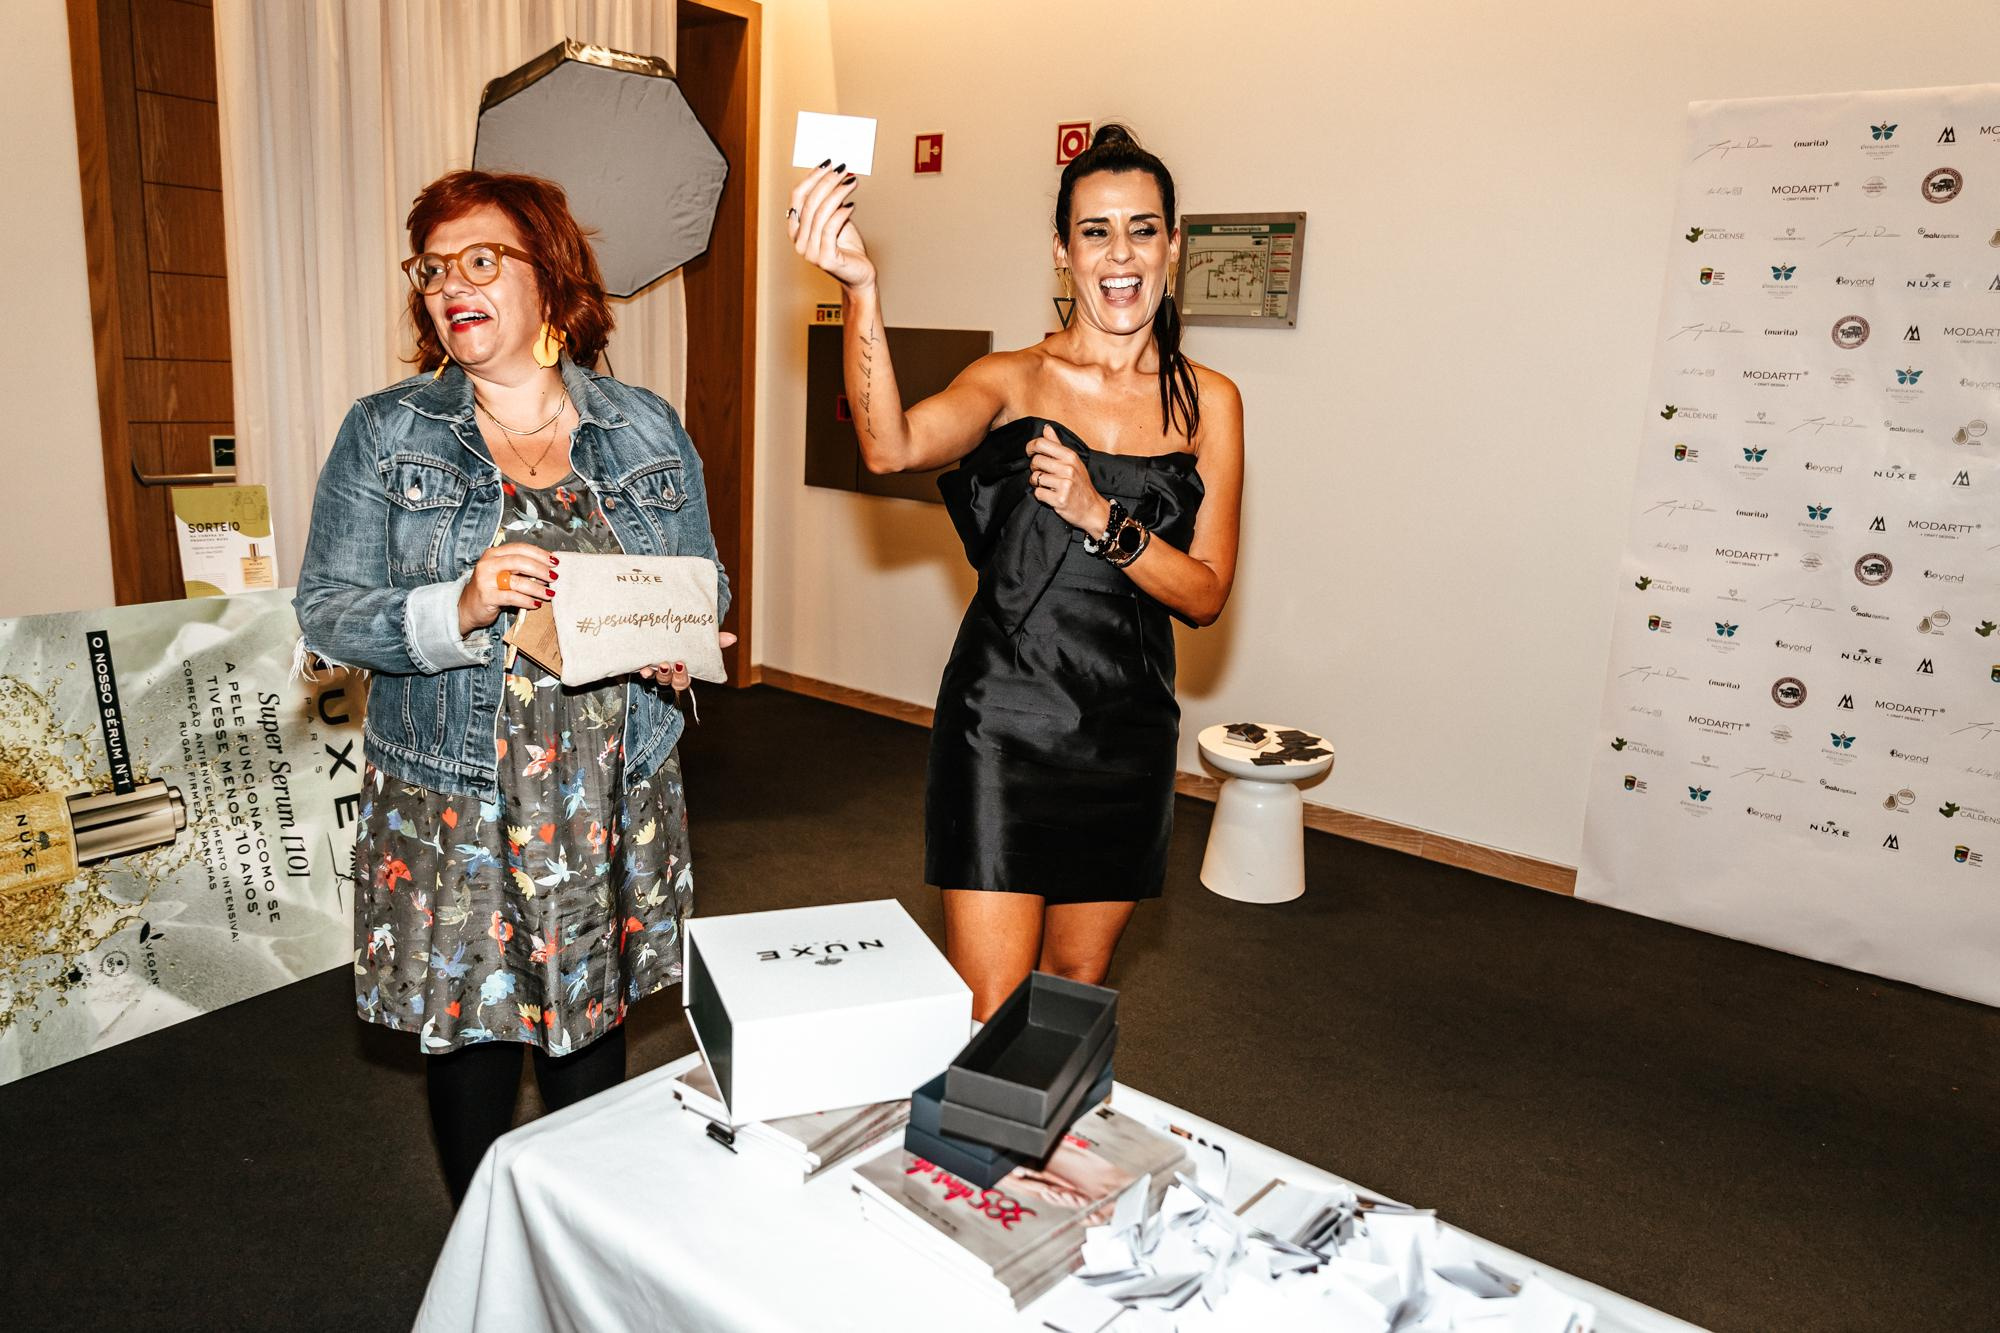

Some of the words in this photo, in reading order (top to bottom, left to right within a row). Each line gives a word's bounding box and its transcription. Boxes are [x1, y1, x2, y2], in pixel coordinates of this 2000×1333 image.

[1793, 139, 1829, 148] (marita)
[1836, 276, 1875, 287] Beyond
[1906, 280, 1952, 289] NUXE
[1765, 328, 1798, 337] (marita)
[1804, 462, 1843, 474] Beyond
[1873, 470, 1918, 481] NUXE
[1736, 509, 1769, 519] (marita)
[188, 522, 240, 534] SORTEIO
[616, 575, 664, 583] NUXE
[1923, 569, 1965, 583] Beyond
[576, 608, 715, 637] #jesuisprodigieuse
[92, 637, 104, 649] O
[1775, 640, 1812, 653] Beyond
[225, 662, 237, 674] A
[1840, 652, 1883, 665] NUXE
[95, 653, 113, 704] NOSSO
[182, 659, 202, 728] CORREÇÃO
[229, 681, 246, 727] PELE
[257, 692, 284, 754] Super
[104, 708, 124, 760] SÉRUM
[303, 697, 324, 774] PARIS
[207, 675, 230, 753] TIVESSE
[221, 761, 242, 827] MENOS
[235, 832, 251, 855] 10
[1889, 749, 1929, 764] Beyond
[237, 734, 262, 832] FUNCIONA
[268, 759, 297, 830] Serum
[1746, 806, 1782, 823] Beyond
[1809, 823, 1851, 838] NUXE
[15, 814, 37, 875] NUXE
[199, 831, 218, 890] MANCHAS
[256, 838, 275, 892] COMO
[280, 835, 311, 877] [10]
[267, 899, 281, 923] SE
[756, 939, 885, 962] NUXE
[145, 942, 160, 985] VEGAN
